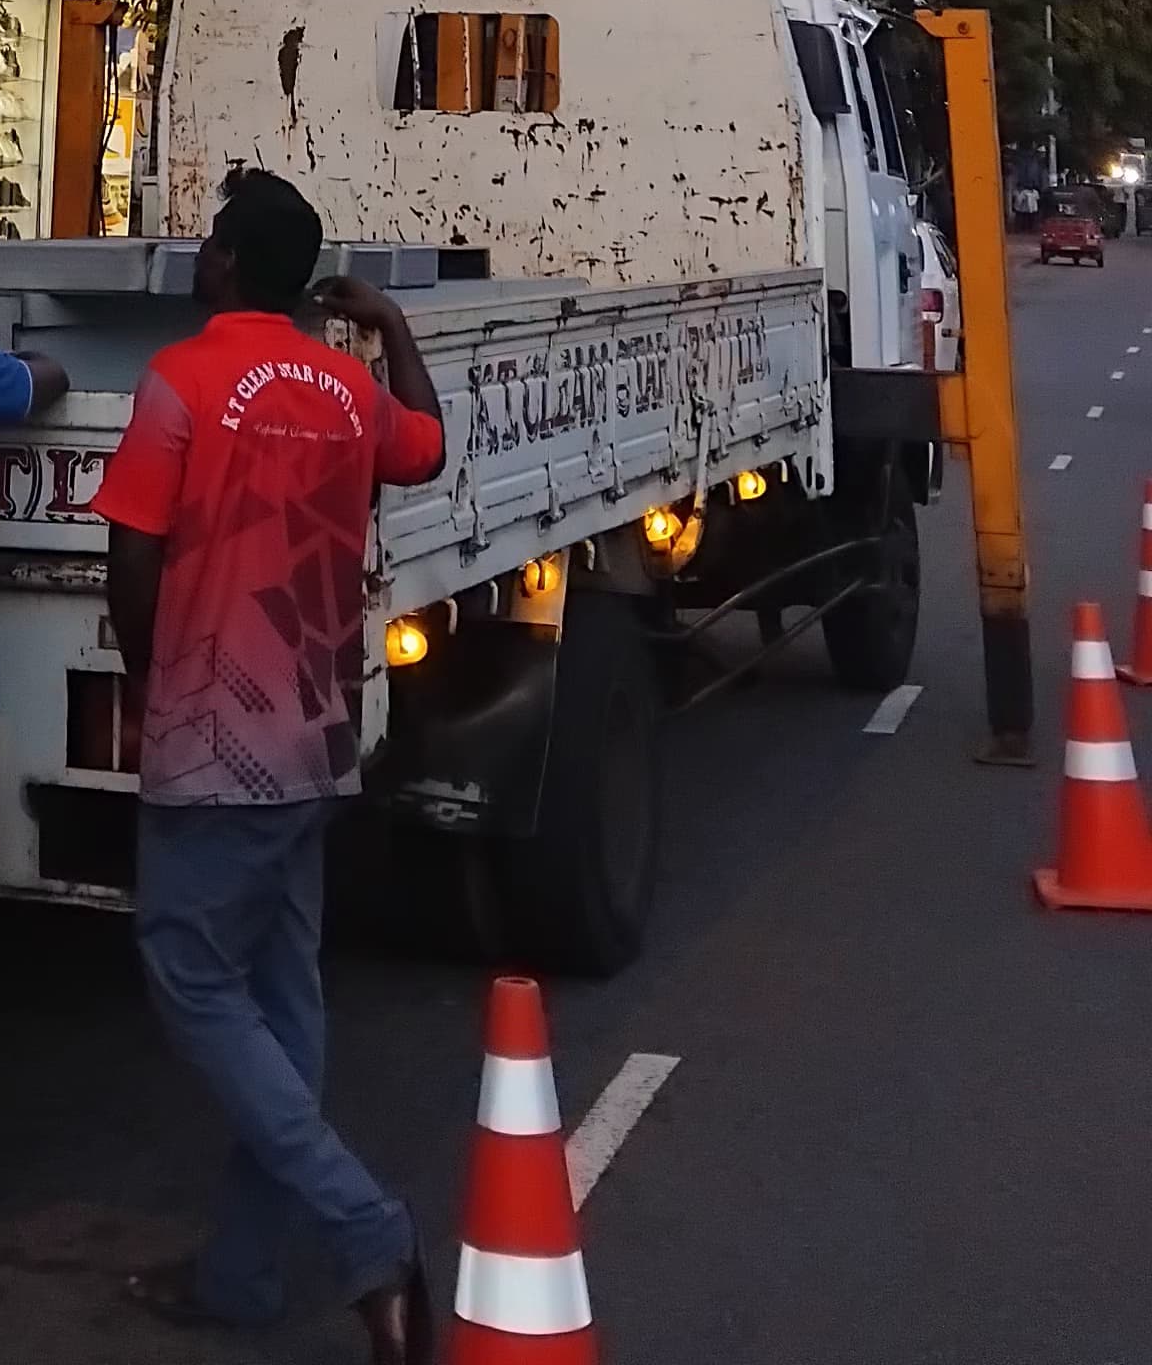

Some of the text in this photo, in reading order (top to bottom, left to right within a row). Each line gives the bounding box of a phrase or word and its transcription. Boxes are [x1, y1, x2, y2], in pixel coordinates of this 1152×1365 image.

[236, 362, 275, 400] CLEAN
[277, 363, 314, 383] STAR
[318, 371, 352, 411] (PVT)
[228, 397, 245, 413] T
[221, 413, 241, 431] K
